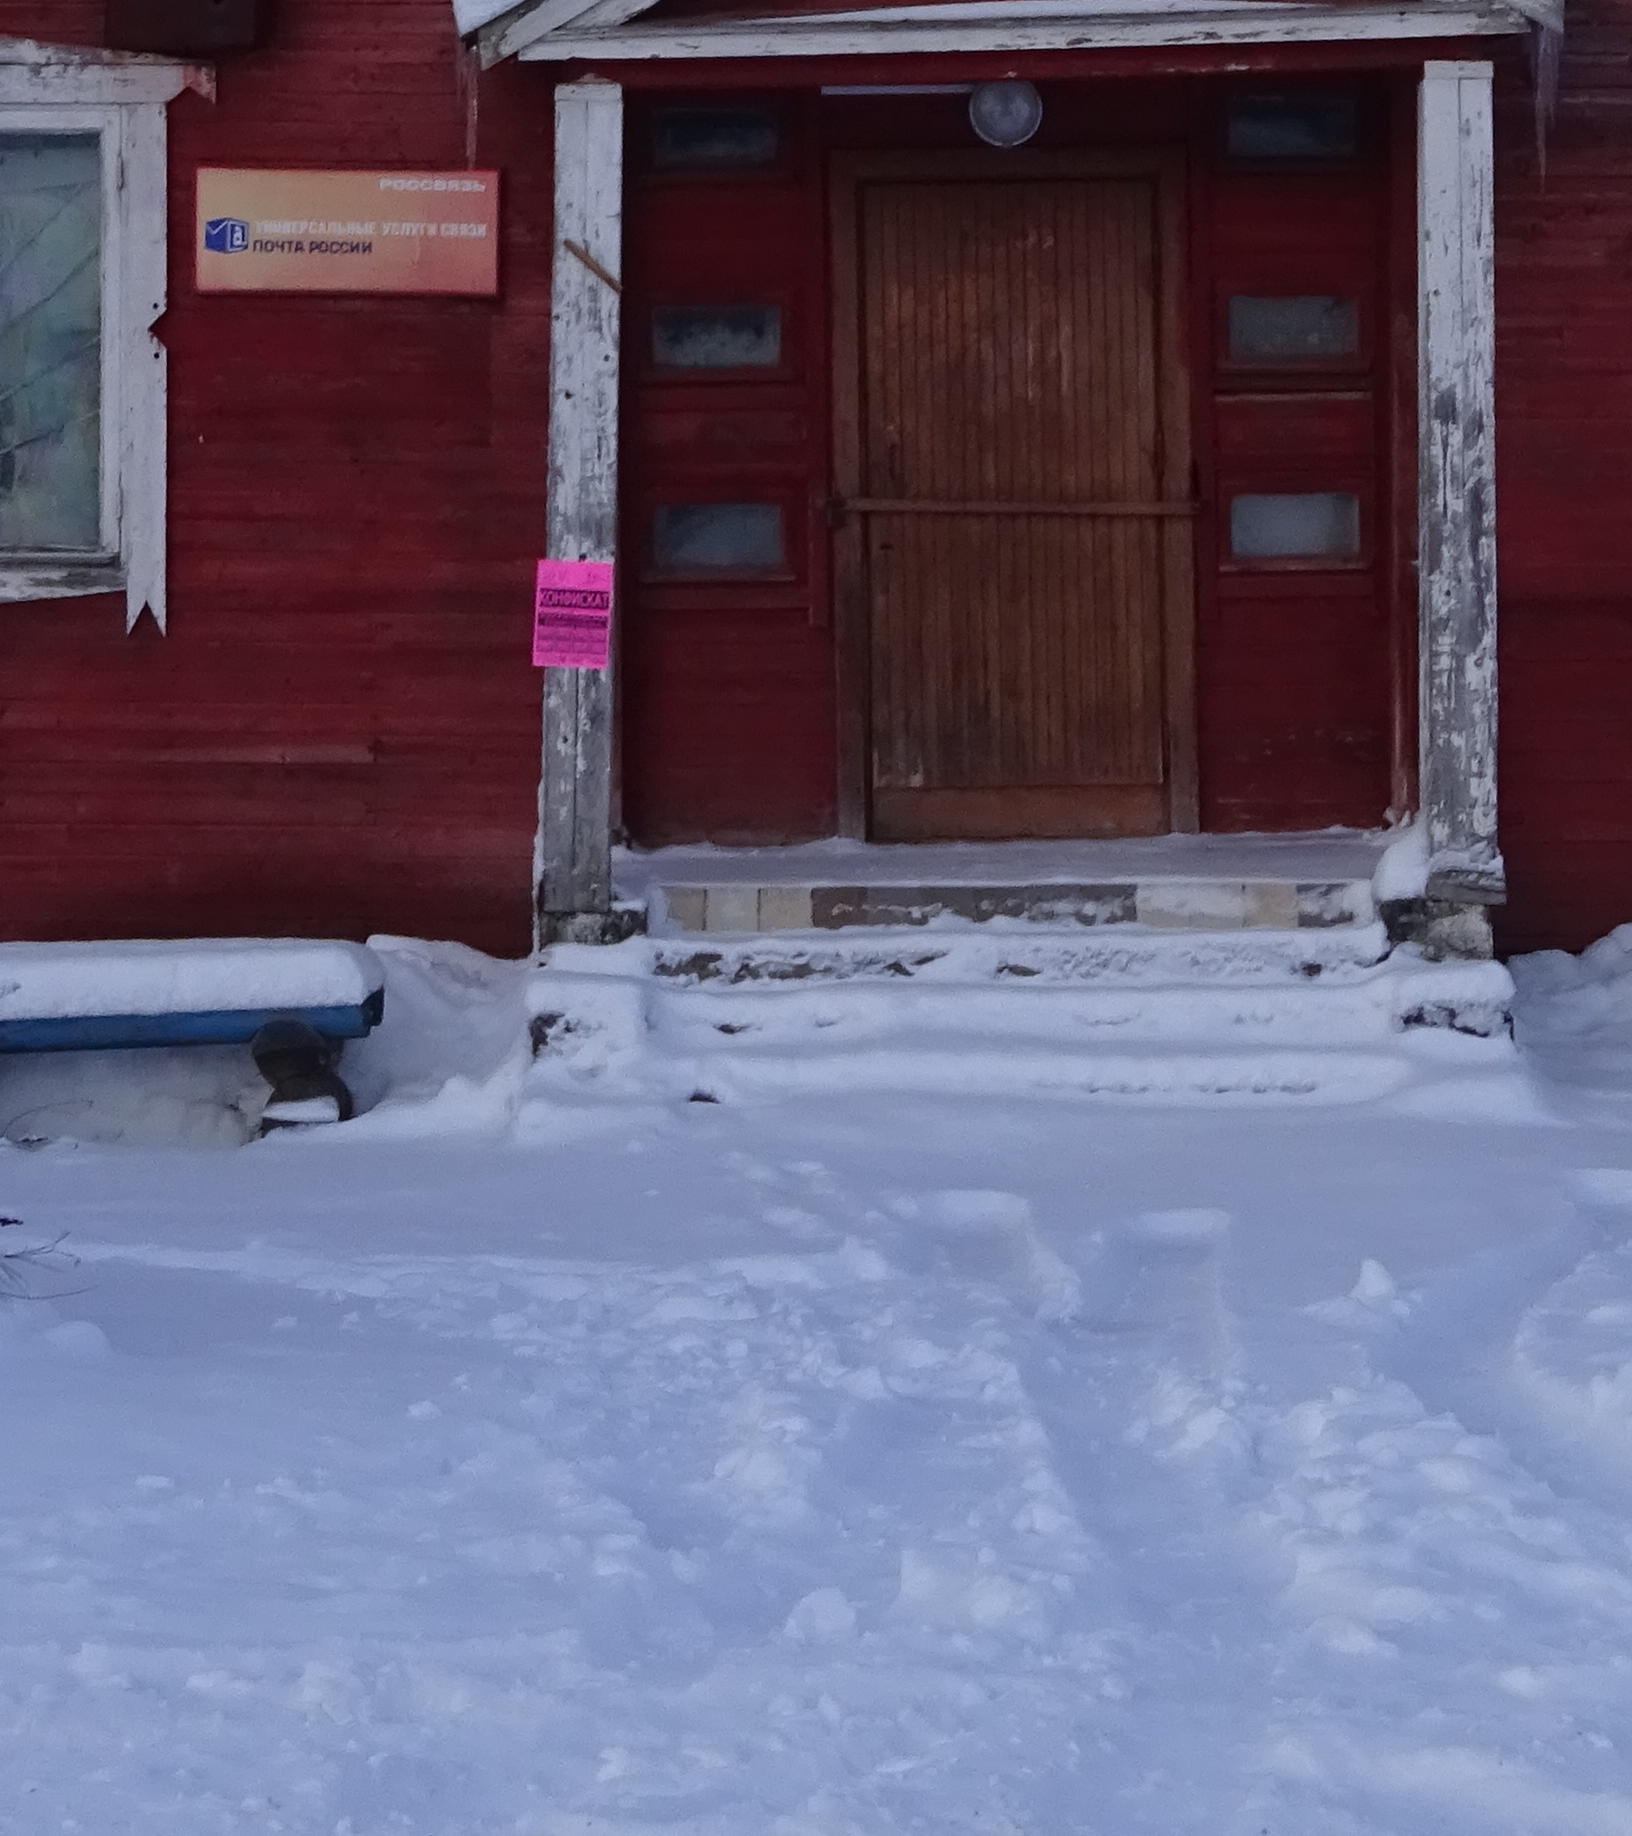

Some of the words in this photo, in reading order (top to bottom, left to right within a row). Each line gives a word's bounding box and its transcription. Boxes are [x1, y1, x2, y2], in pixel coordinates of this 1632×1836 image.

[379, 178, 486, 192] РОССВЯЗЬ
[382, 222, 437, 237] УСЛУГИ
[440, 222, 487, 238] СВЯЗИ
[253, 239, 306, 253] ПОЧТА
[309, 240, 373, 255] РОССИИ
[539, 590, 609, 610] КОНФИСКАТ
